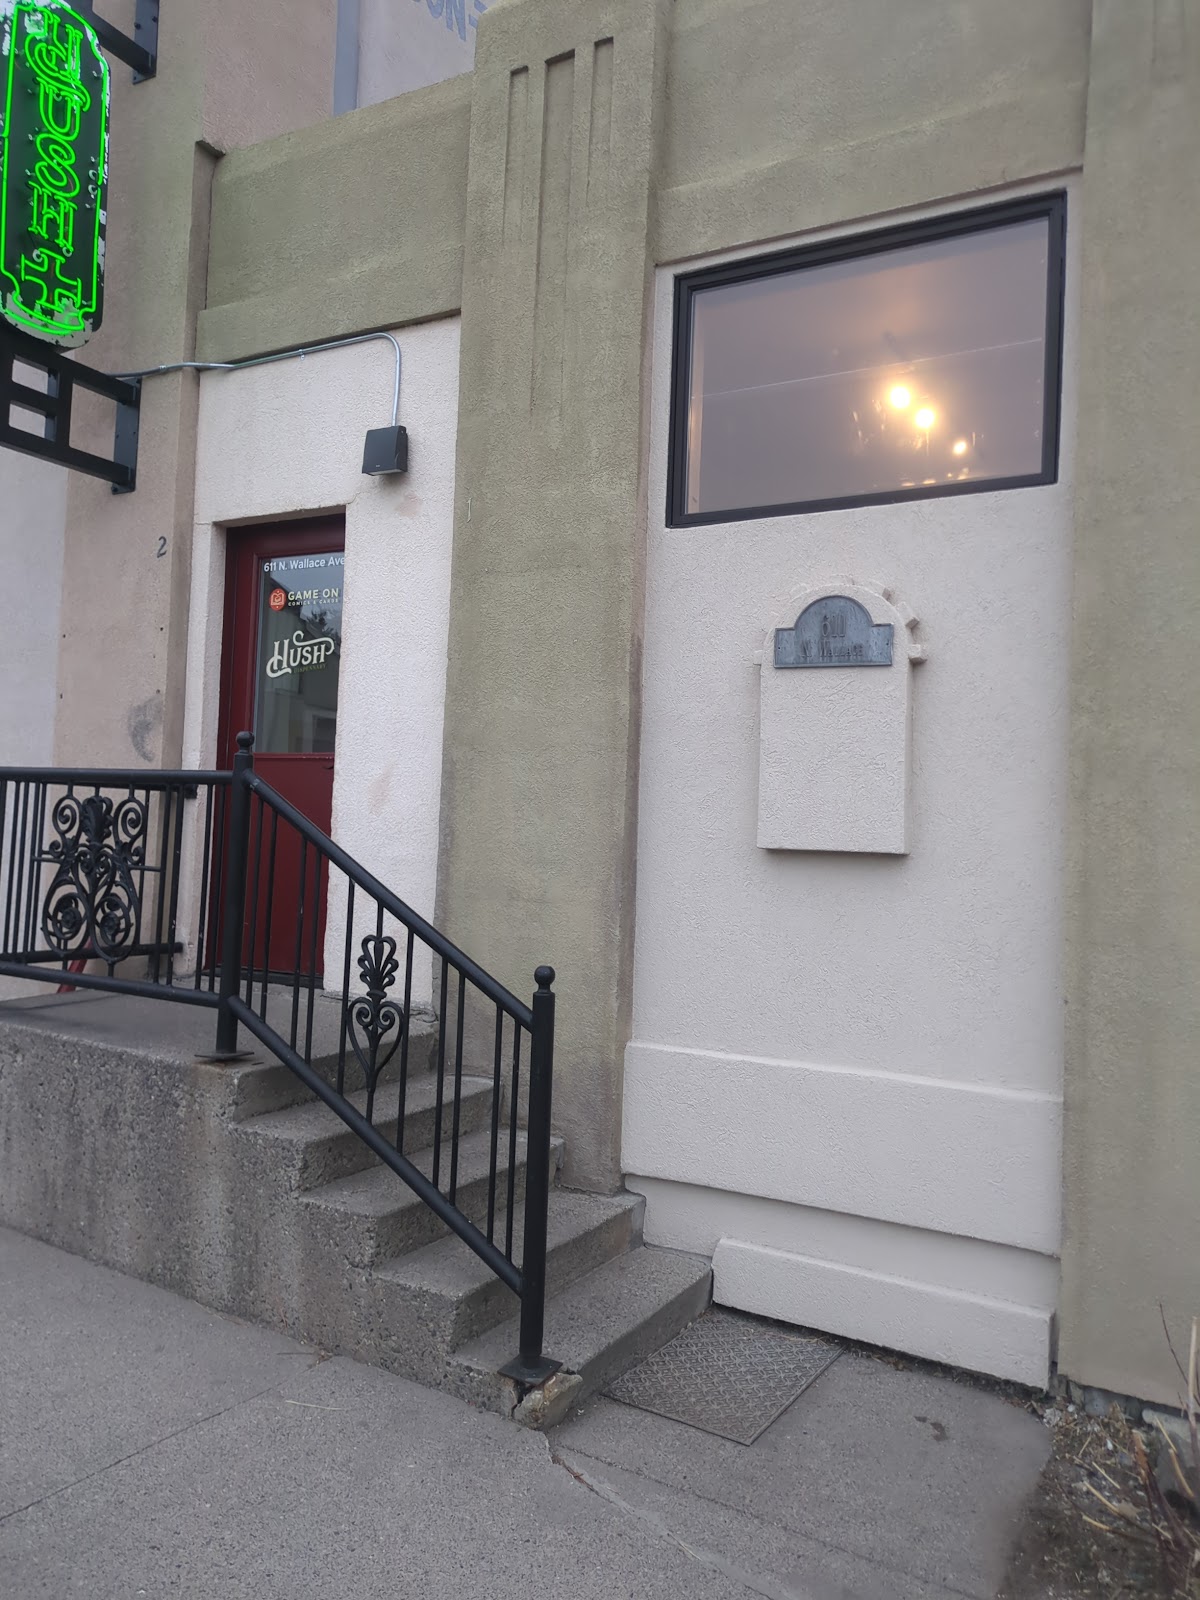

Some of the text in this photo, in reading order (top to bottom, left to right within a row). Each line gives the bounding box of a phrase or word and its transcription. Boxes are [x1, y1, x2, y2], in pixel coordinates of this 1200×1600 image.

[157, 536, 168, 559] 2
[263, 561, 277, 572] 611
[278, 560, 288, 571] N.
[289, 558, 326, 570] Wallace
[287, 587, 339, 601] GAME ON
[821, 613, 847, 638] 611
